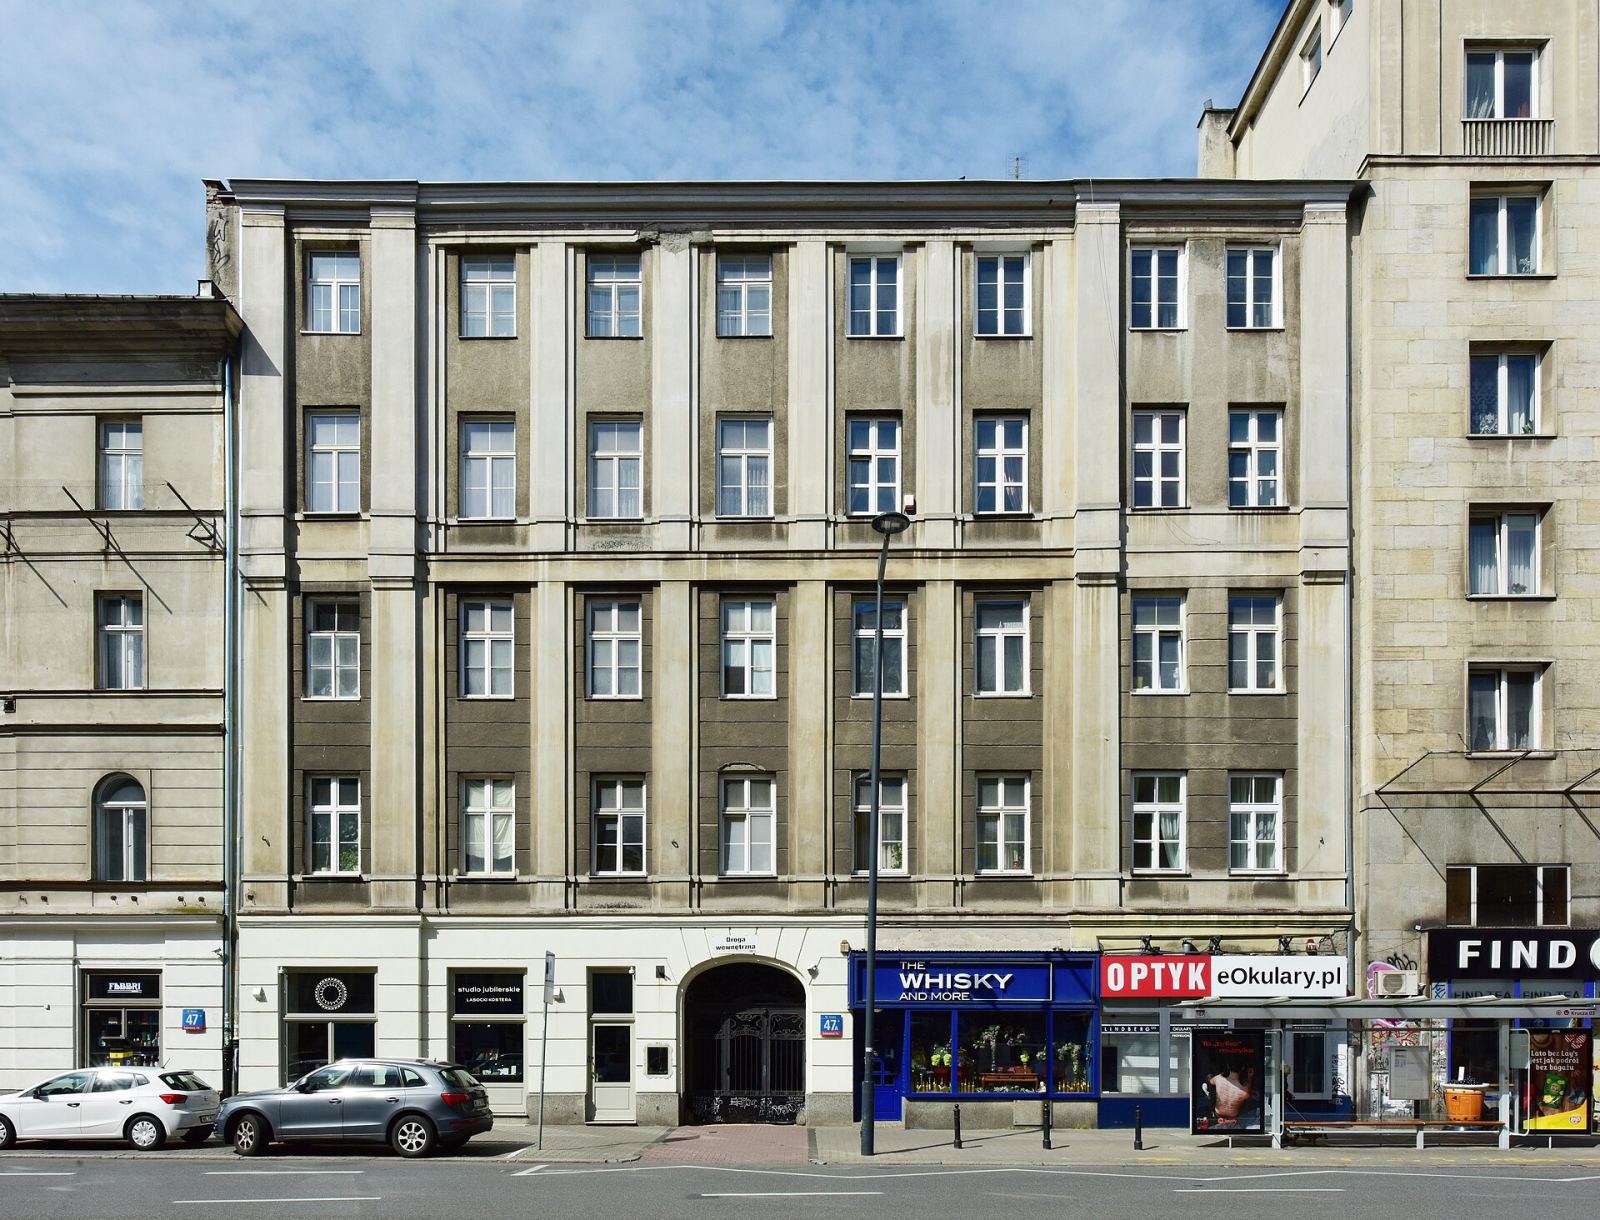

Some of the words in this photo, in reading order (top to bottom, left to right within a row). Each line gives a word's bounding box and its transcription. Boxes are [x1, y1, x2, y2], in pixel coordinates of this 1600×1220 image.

[1458, 940, 1577, 969] FIND
[900, 961, 926, 970] THE
[899, 973, 1014, 990] WHISKY
[1107, 962, 1206, 992] OPTYK
[1217, 966, 1341, 989] eOkulary.pl
[108, 982, 141, 991] FABBRI
[482, 986, 521, 994] jubilerskie
[899, 992, 928, 1001] AND
[930, 992, 970, 1001] MORE
[185, 1013, 199, 1026] 47
[1561, 1050, 1578, 1059] Lay's
